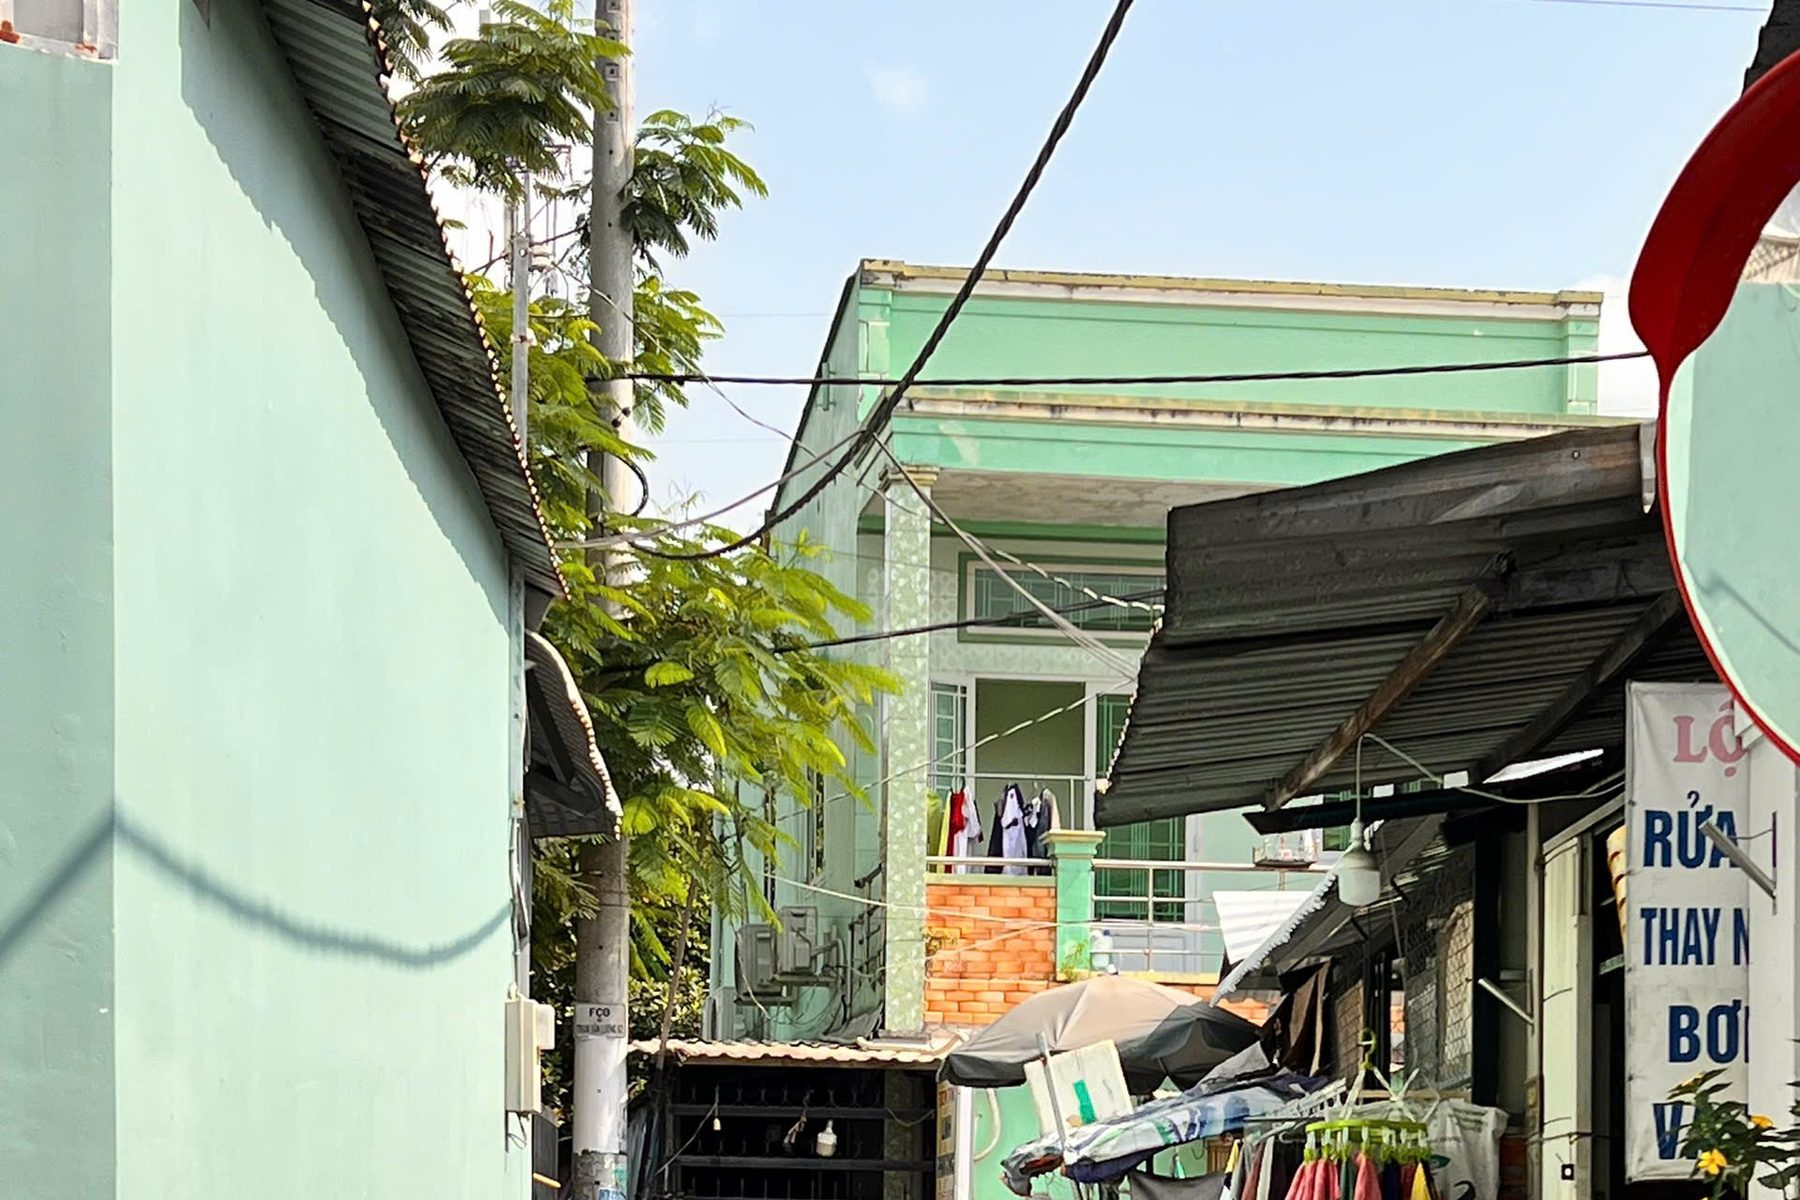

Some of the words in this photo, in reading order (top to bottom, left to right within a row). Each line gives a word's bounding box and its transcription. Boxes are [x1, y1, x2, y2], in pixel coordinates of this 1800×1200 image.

[1643, 790, 1740, 869] RỬA
[1640, 908, 1721, 966] THAY
[589, 1007, 610, 1018] FCO
[1668, 999, 1749, 1064] BƠ
